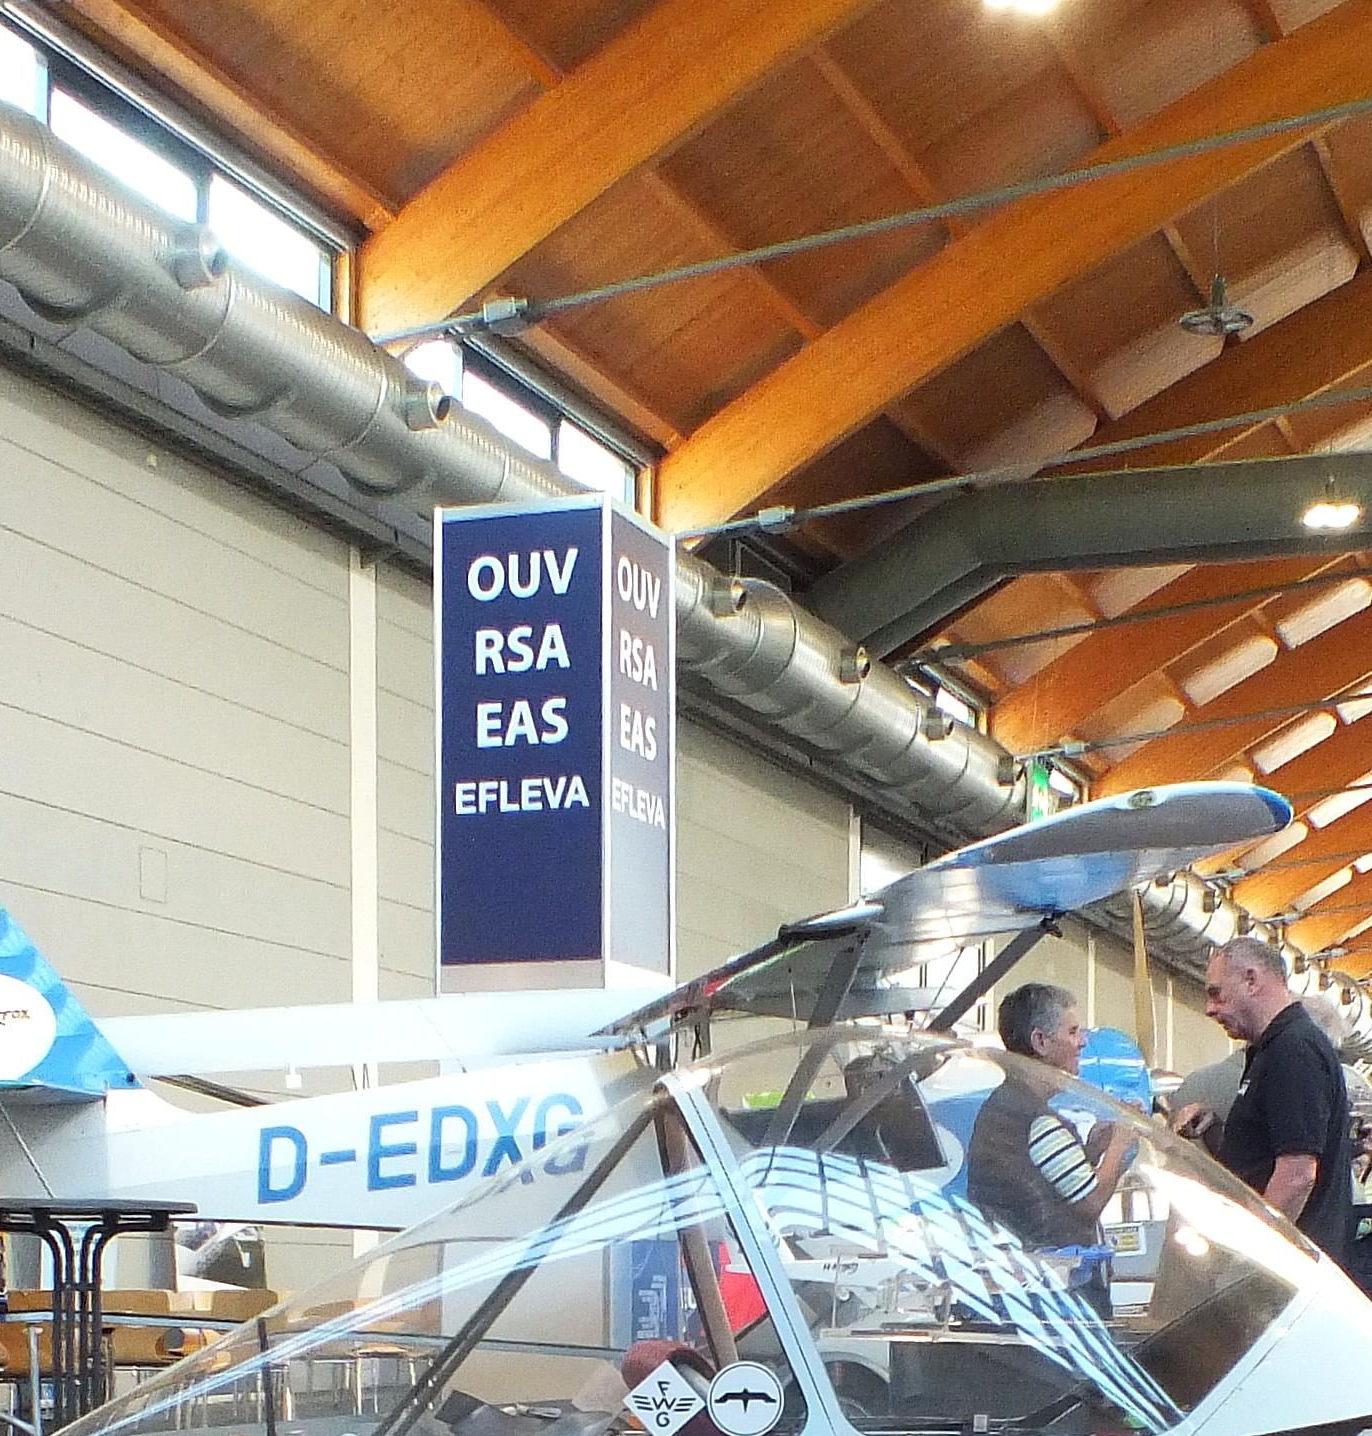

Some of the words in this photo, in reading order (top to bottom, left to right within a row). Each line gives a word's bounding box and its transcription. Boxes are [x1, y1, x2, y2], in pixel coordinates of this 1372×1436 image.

[467, 548, 579, 601] OUV
[617, 556, 661, 619] OUV
[475, 624, 571, 676] RSA
[620, 629, 658, 691] RSA
[477, 698, 569, 748] EAS
[620, 703, 657, 761] EAS
[455, 775, 590, 815] EFLEVA
[612, 777, 666, 829] EFLEVA
[257, 1093, 587, 1205] D-EDXG
